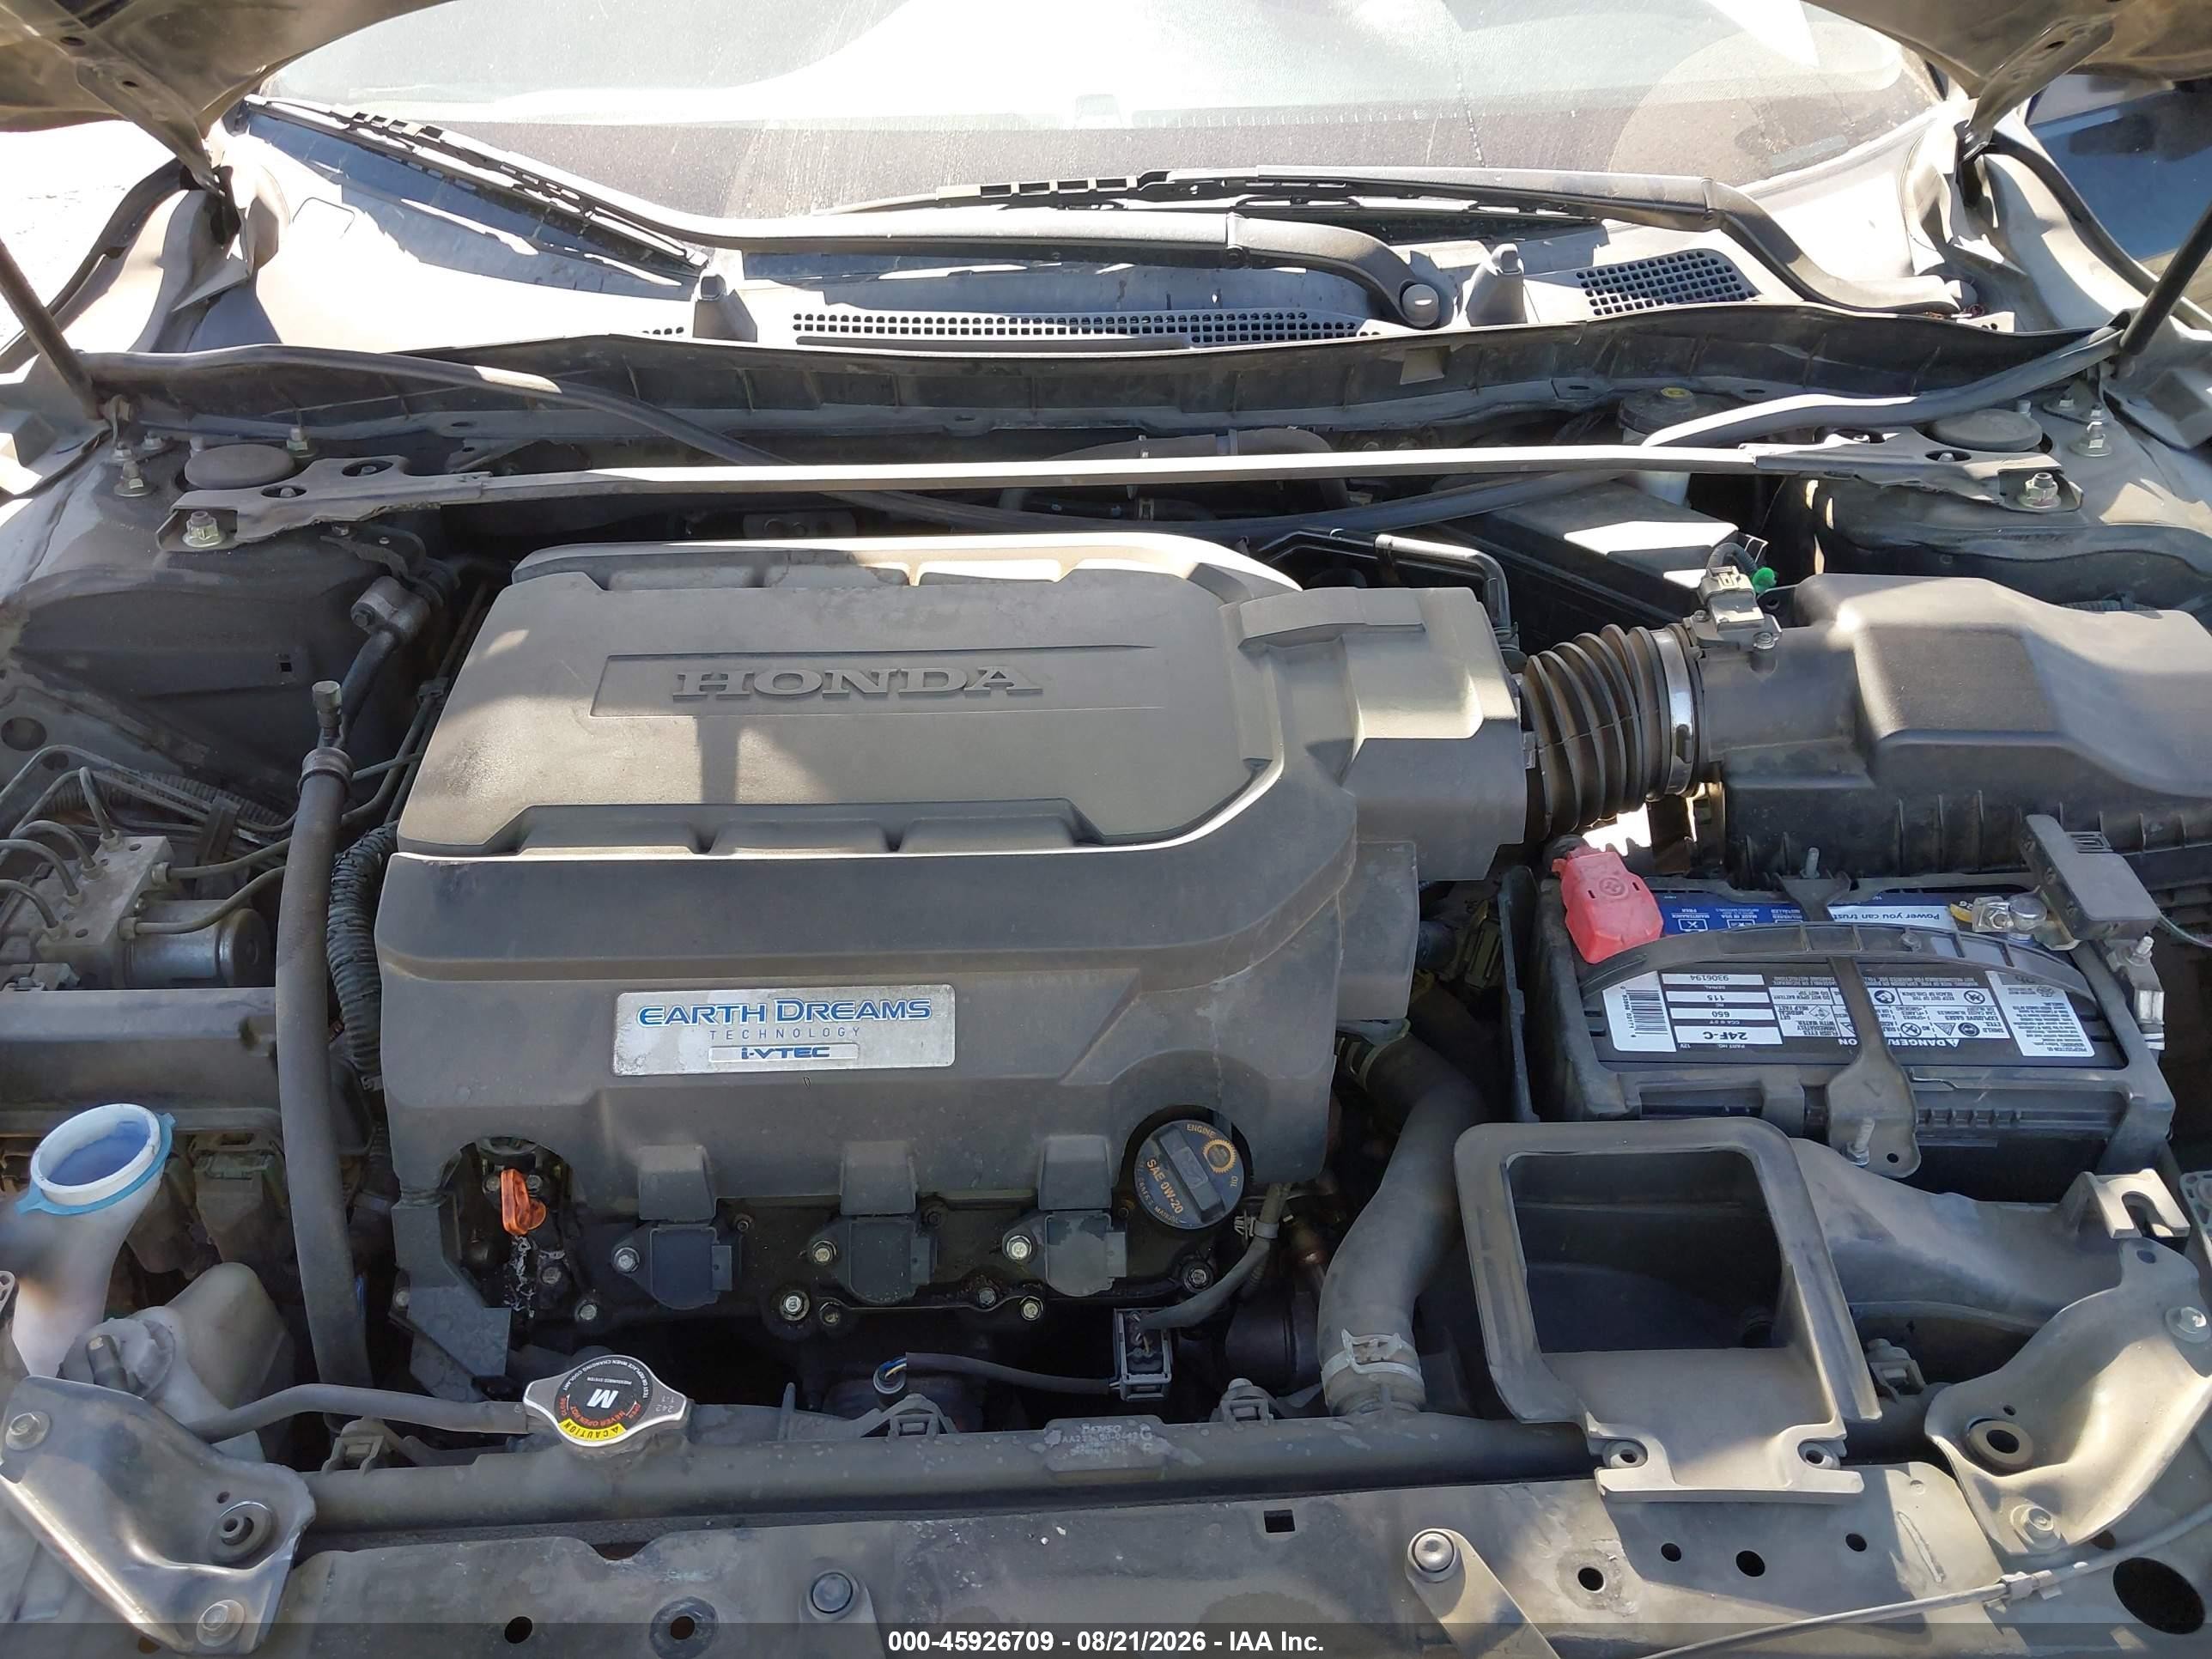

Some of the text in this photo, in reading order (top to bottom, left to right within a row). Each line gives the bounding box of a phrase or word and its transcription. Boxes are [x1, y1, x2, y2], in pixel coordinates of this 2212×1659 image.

[672, 665, 1043, 701] HONDA
[638, 999, 933, 1028] EARTH DREAMS
[708, 1028, 861, 1041] TECHNOLOGY
[1703, 1030, 1747, 1040] 24F-C
[740, 1046, 831, 1060] i-VTEC
[1187, 1123, 1217, 1138] ENGINE
[1147, 1158, 1184, 1214] SAE 0W-20
[582, 1359, 611, 1371] CHANGING
[628, 1363, 645, 1380] REPLACE
[562, 1370, 582, 1390] COOLANT
[586, 1389, 618, 1408] M
[580, 1417, 599, 1426] OPEN
[600, 1411, 626, 1425] NEVER
[563, 1421, 609, 1437] CAUTION
